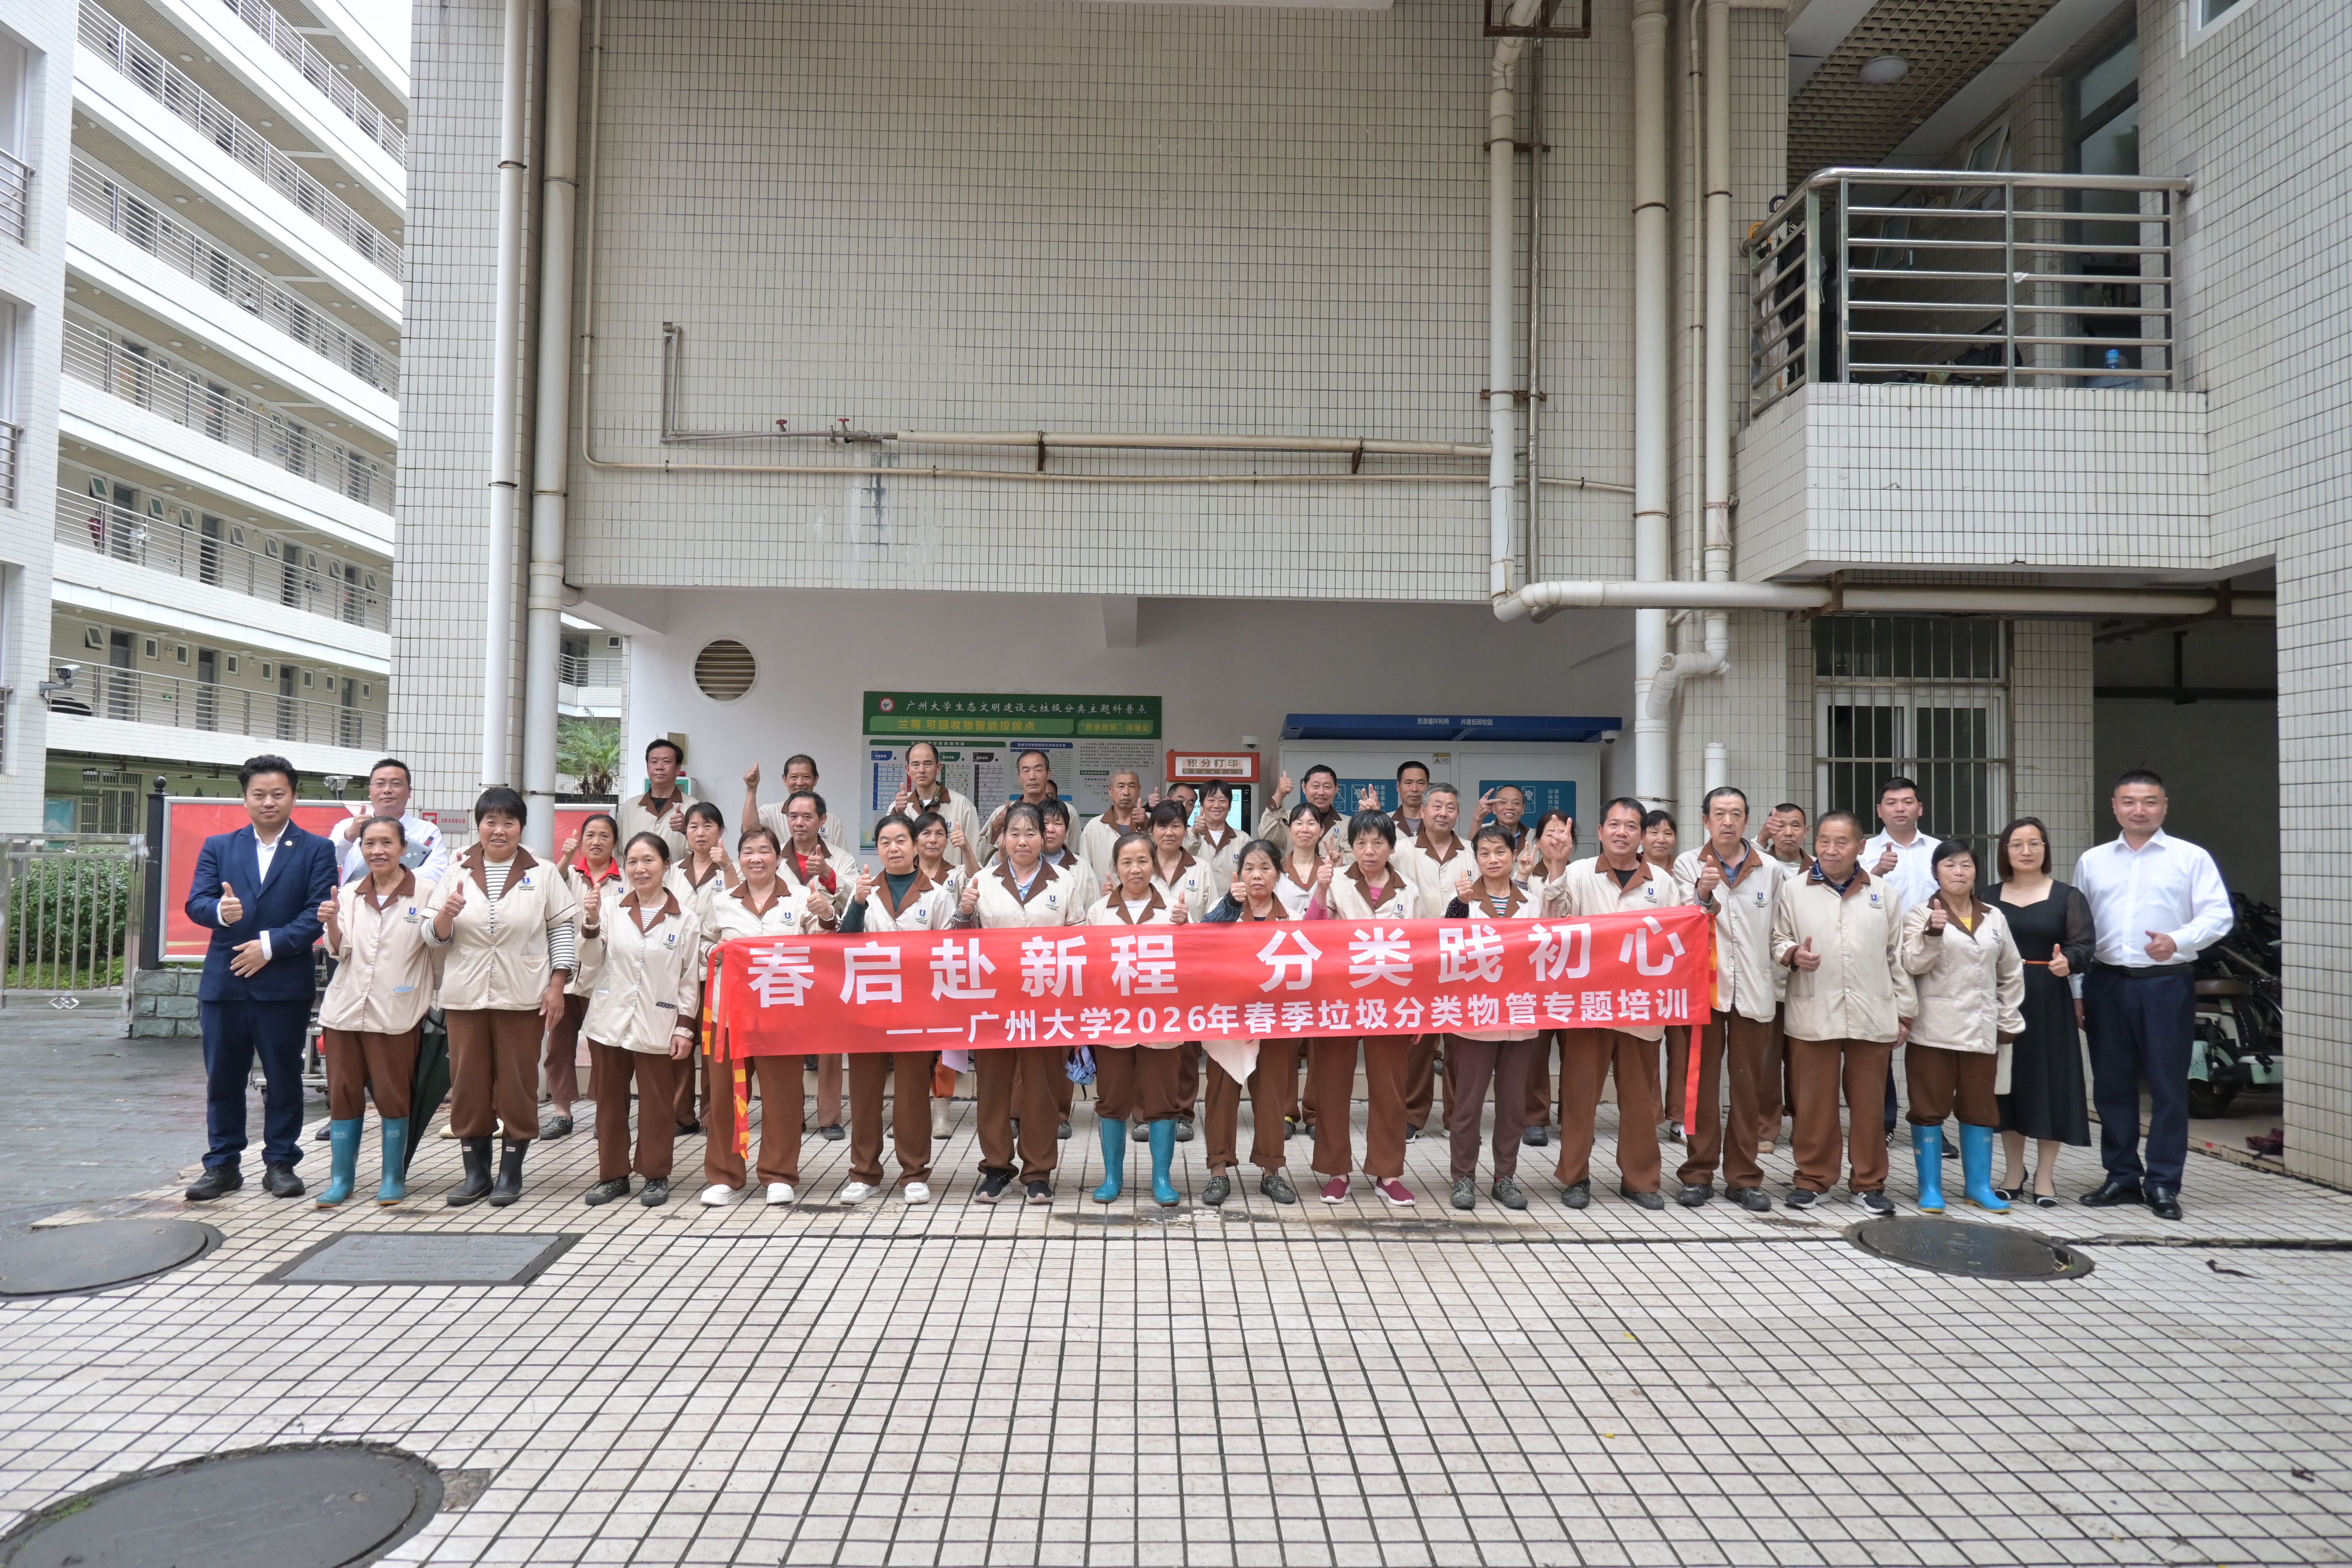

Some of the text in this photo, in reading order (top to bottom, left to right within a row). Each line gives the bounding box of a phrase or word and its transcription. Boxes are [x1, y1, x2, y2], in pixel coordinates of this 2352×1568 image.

[906, 700, 1146, 714] 广州大学生态文明建设之垃圾分类主题科普点
[898, 719, 1034, 731] 兰苑 可回收物智能投放点
[1126, 724, 1150, 732] 拆箱处
[1187, 759, 1238, 768] 积分打印
[409, 907, 416, 915] U
[668, 934, 675, 942] U
[748, 915, 1685, 1008] 春启赴新程 分类践初心
